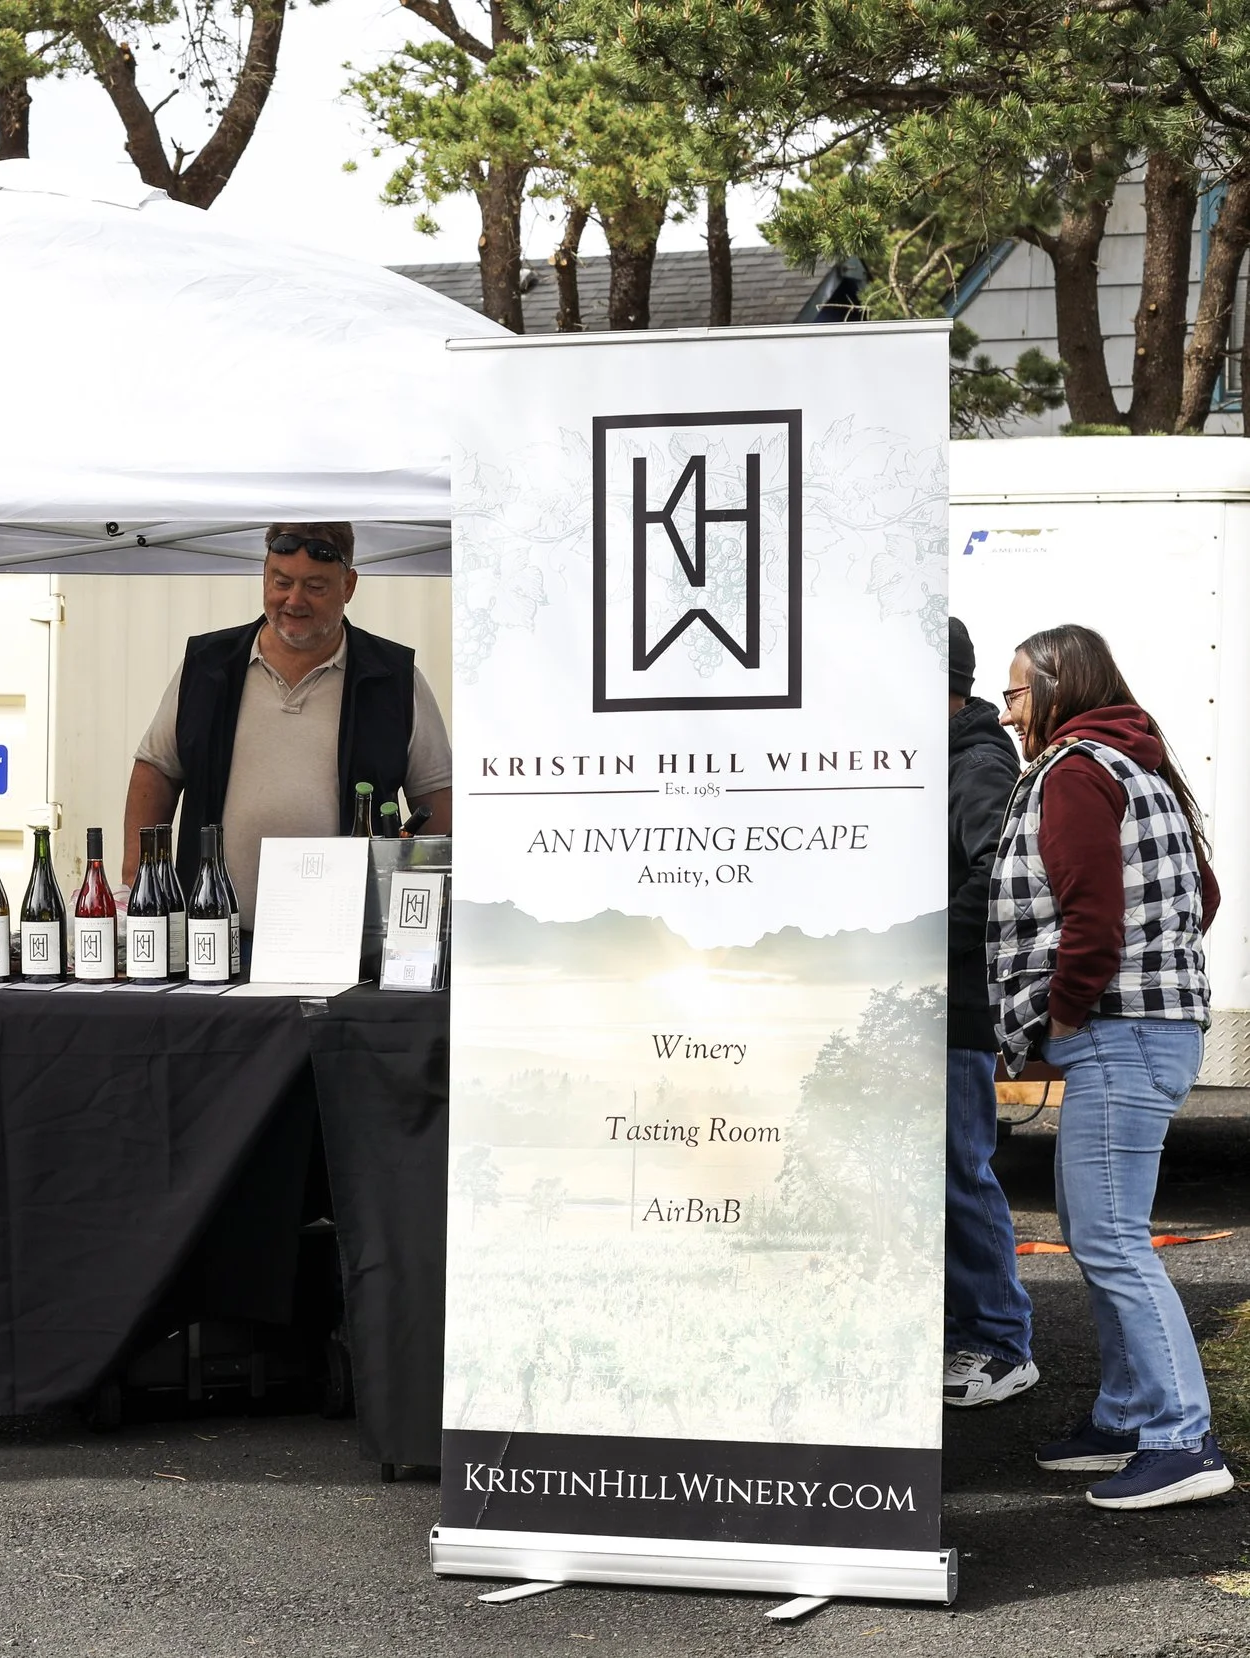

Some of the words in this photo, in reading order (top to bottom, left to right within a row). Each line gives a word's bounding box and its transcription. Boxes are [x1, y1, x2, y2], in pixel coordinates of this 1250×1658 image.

[481, 753, 636, 778] KRISTIN
[658, 752, 746, 774] HILL
[766, 749, 920, 773] WINERY
[664, 782, 691, 797] Est.
[693, 782, 722, 799] 1985
[527, 828, 576, 855] AN
[583, 826, 737, 854] INVITING
[744, 824, 869, 852] ESCAPE
[637, 864, 710, 888] Amity,
[715, 864, 753, 885] OR
[650, 1033, 747, 1066] Winery
[605, 1114, 701, 1149] Tasting
[707, 1116, 782, 1144] Room
[641, 1198, 742, 1225] AirBnB
